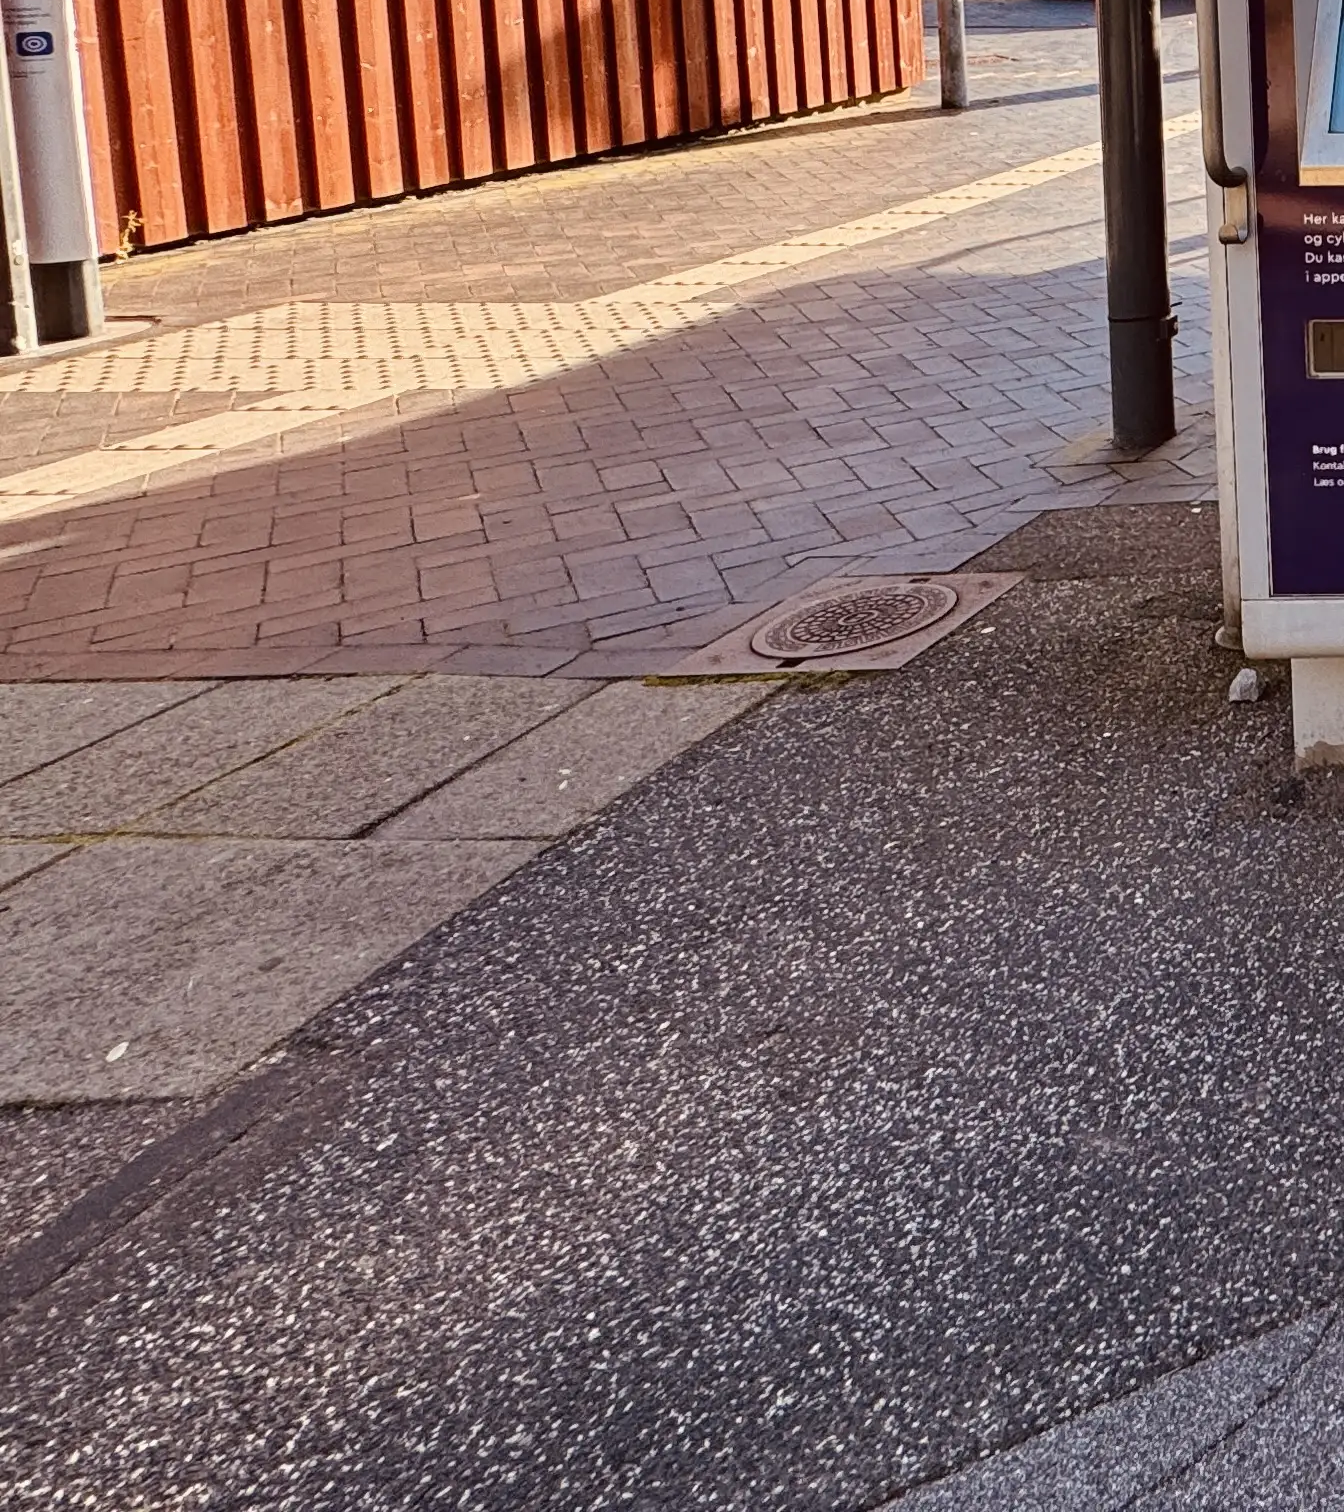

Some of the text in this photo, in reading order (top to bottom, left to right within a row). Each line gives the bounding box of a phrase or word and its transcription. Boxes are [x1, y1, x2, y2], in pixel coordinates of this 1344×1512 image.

[1303, 214, 1327, 224] Her
[1304, 234, 1323, 246] og
[1305, 252, 1323, 263] Du
[1305, 270, 1310, 282] i
[1312, 445, 1338, 456] Brug
[1313, 477, 1335, 486] Læs
